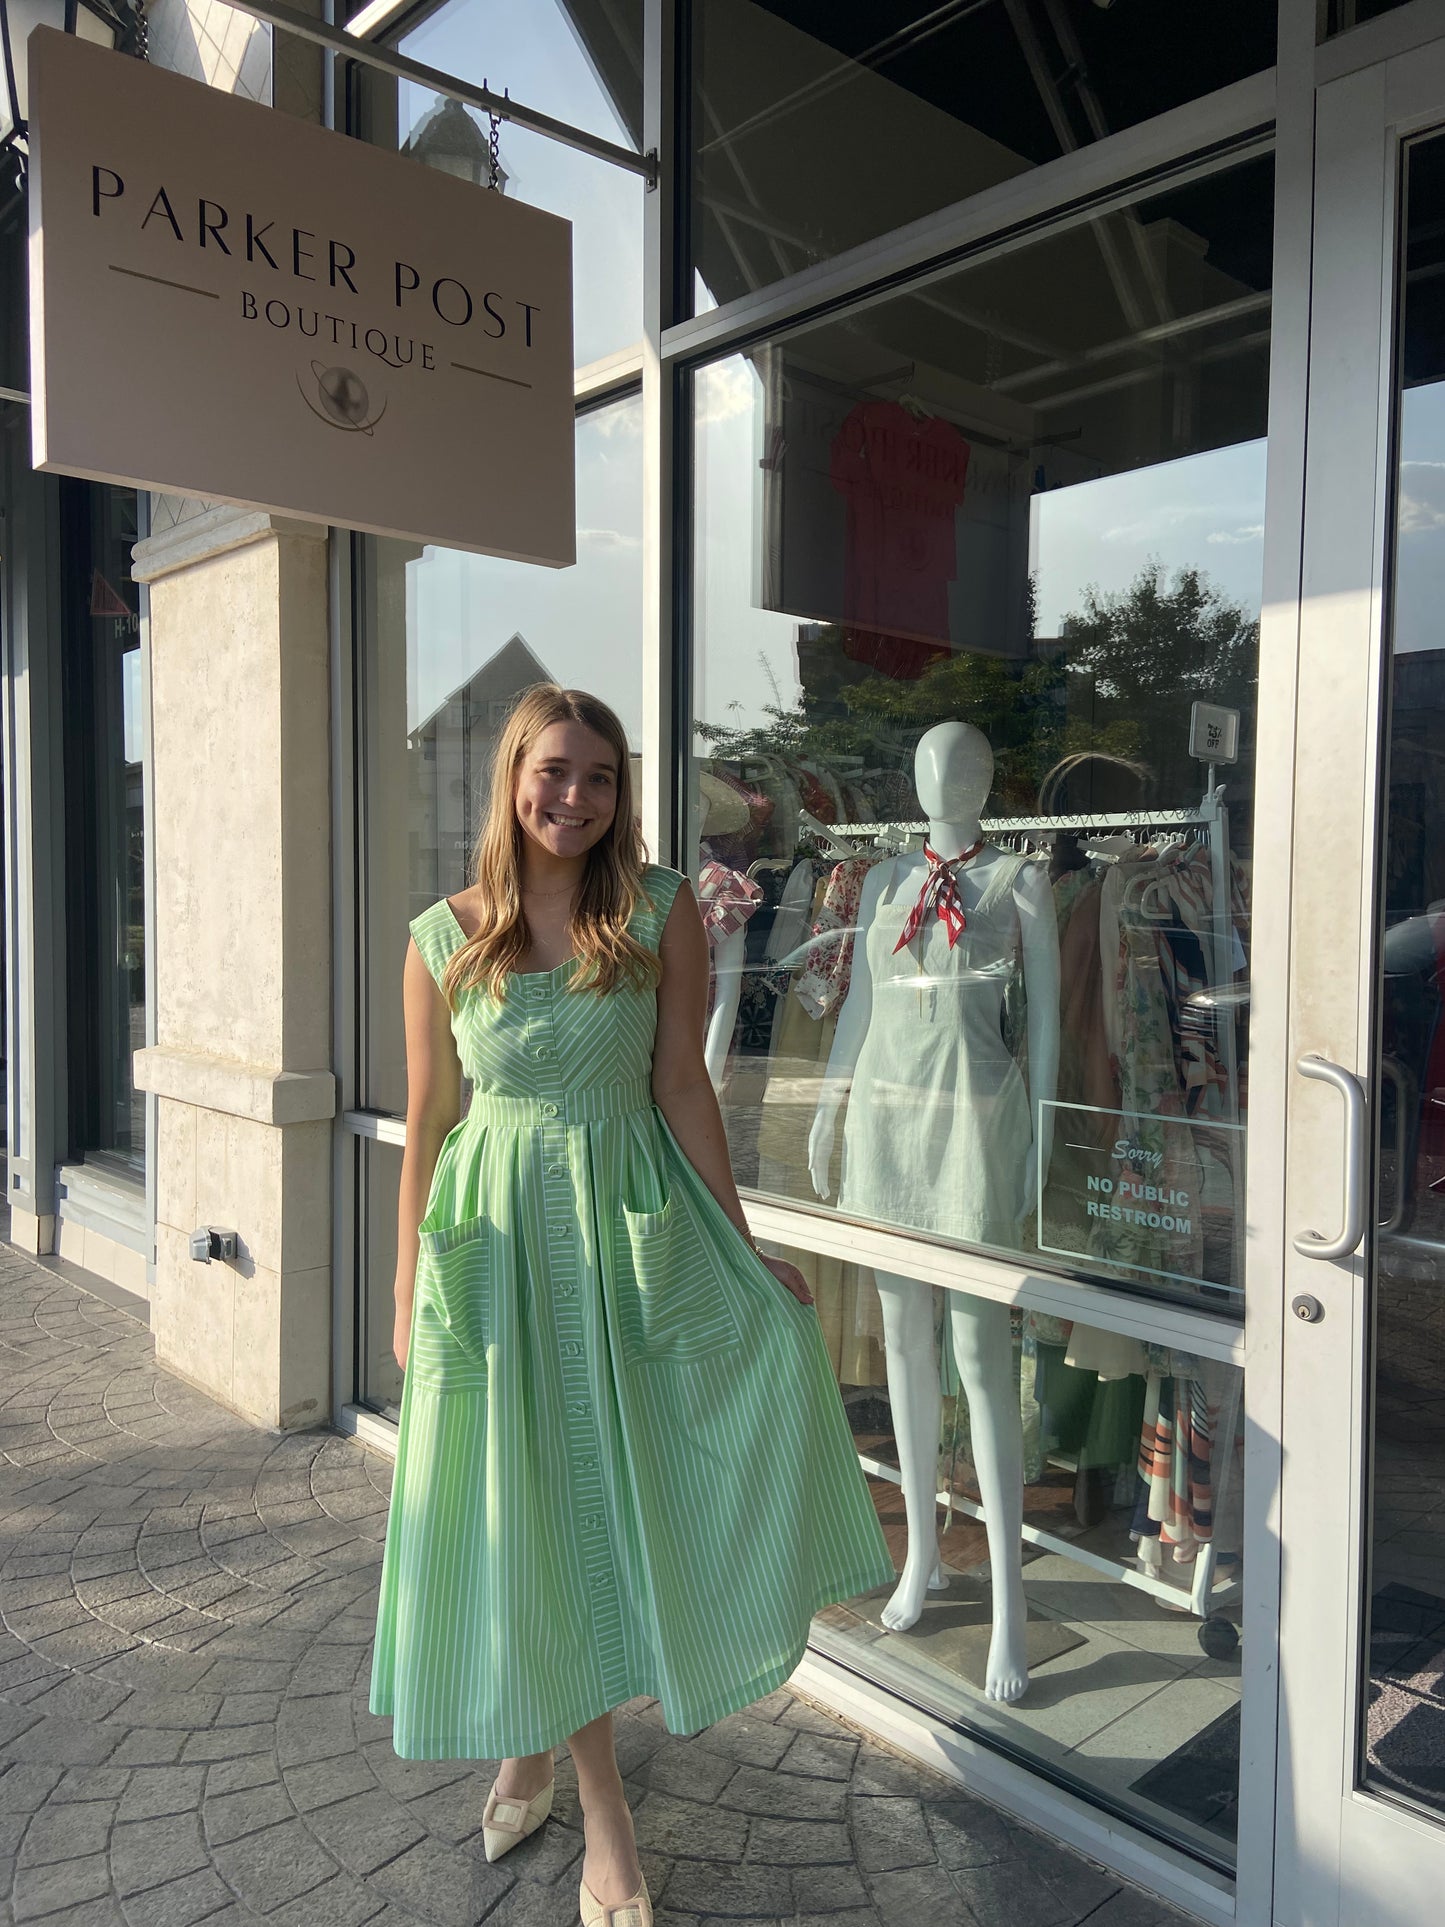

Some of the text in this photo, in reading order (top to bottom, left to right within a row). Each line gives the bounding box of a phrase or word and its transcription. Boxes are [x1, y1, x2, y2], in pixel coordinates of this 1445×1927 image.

[91, 164, 541, 348] PARKER POST
[240, 291, 437, 371] BOUTIQUE
[1206, 738, 1220, 749] OFF
[1111, 1139, 1164, 1169] Sorry
[1086, 1175, 1190, 1207] NO PUBLIC
[1086, 1201, 1192, 1235] RESTROOM
